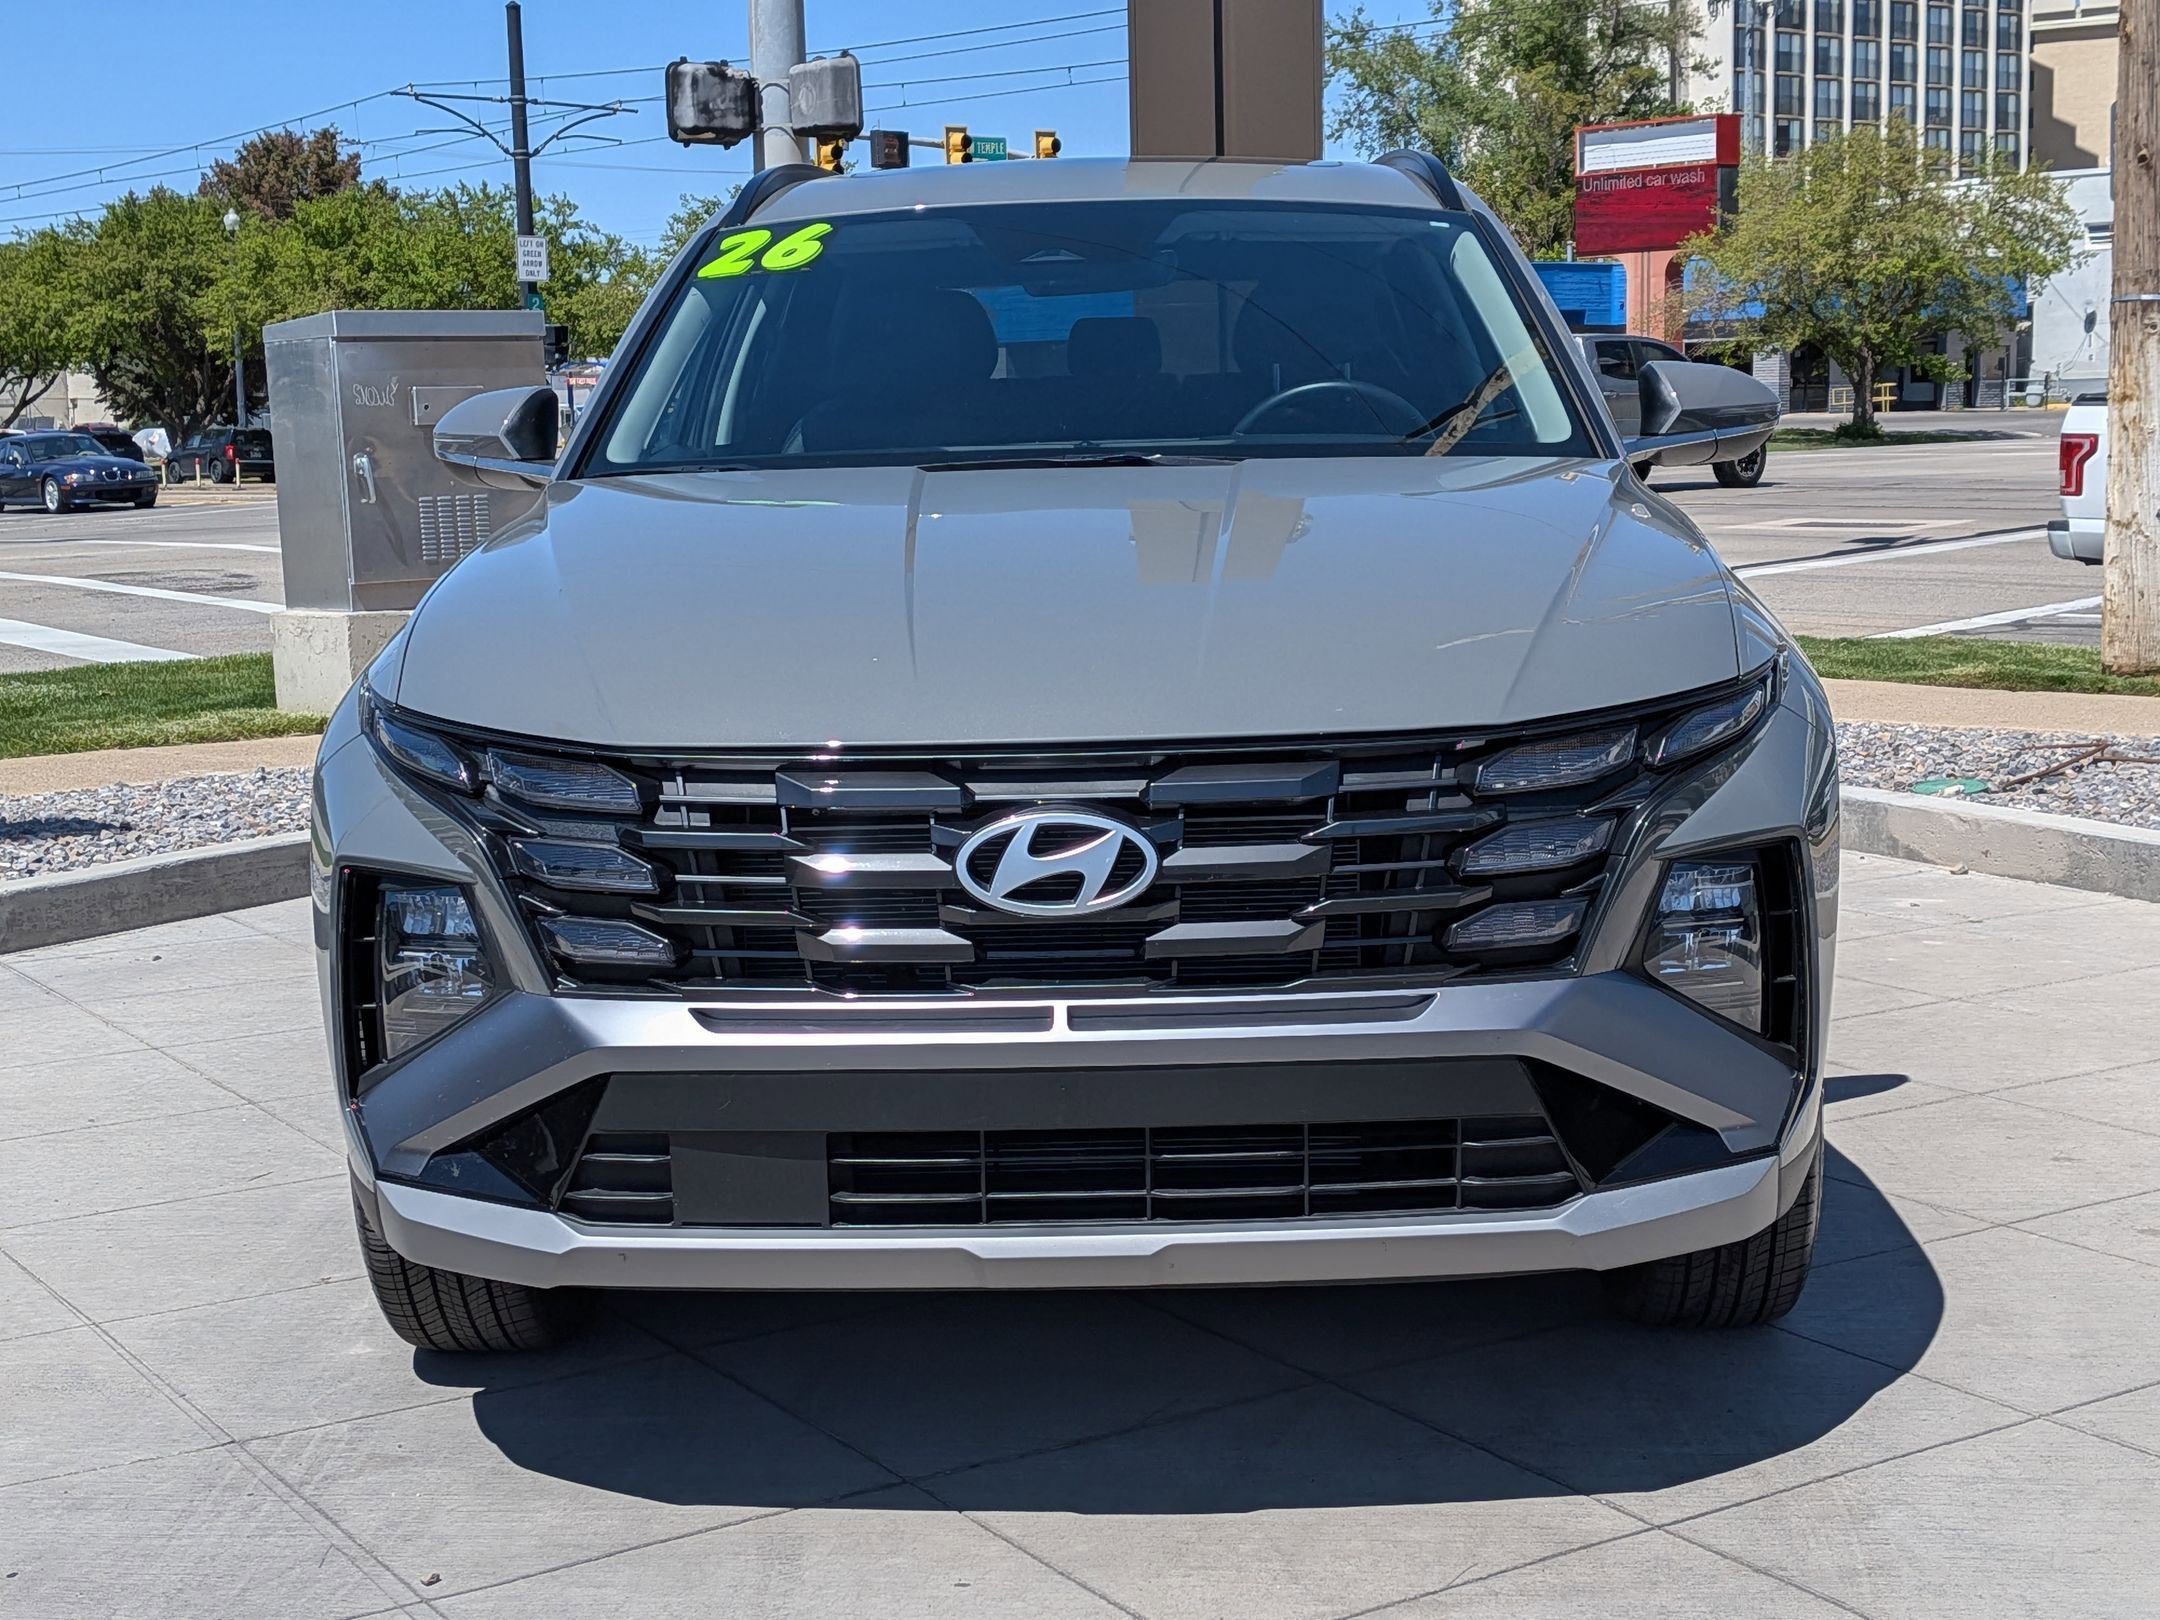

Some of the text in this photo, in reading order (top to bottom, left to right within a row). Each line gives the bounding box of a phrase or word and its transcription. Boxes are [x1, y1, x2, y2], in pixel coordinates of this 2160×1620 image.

[977, 142, 1005, 154] TEMPLE
[1582, 168, 1705, 192] Unlimited car wash
[519, 240, 544, 248] LEFT ON
[522, 249, 542, 257] GREEN
[698, 223, 833, 278] 26
[522, 259, 543, 267] ARROW
[525, 269, 540, 277] ONLY
